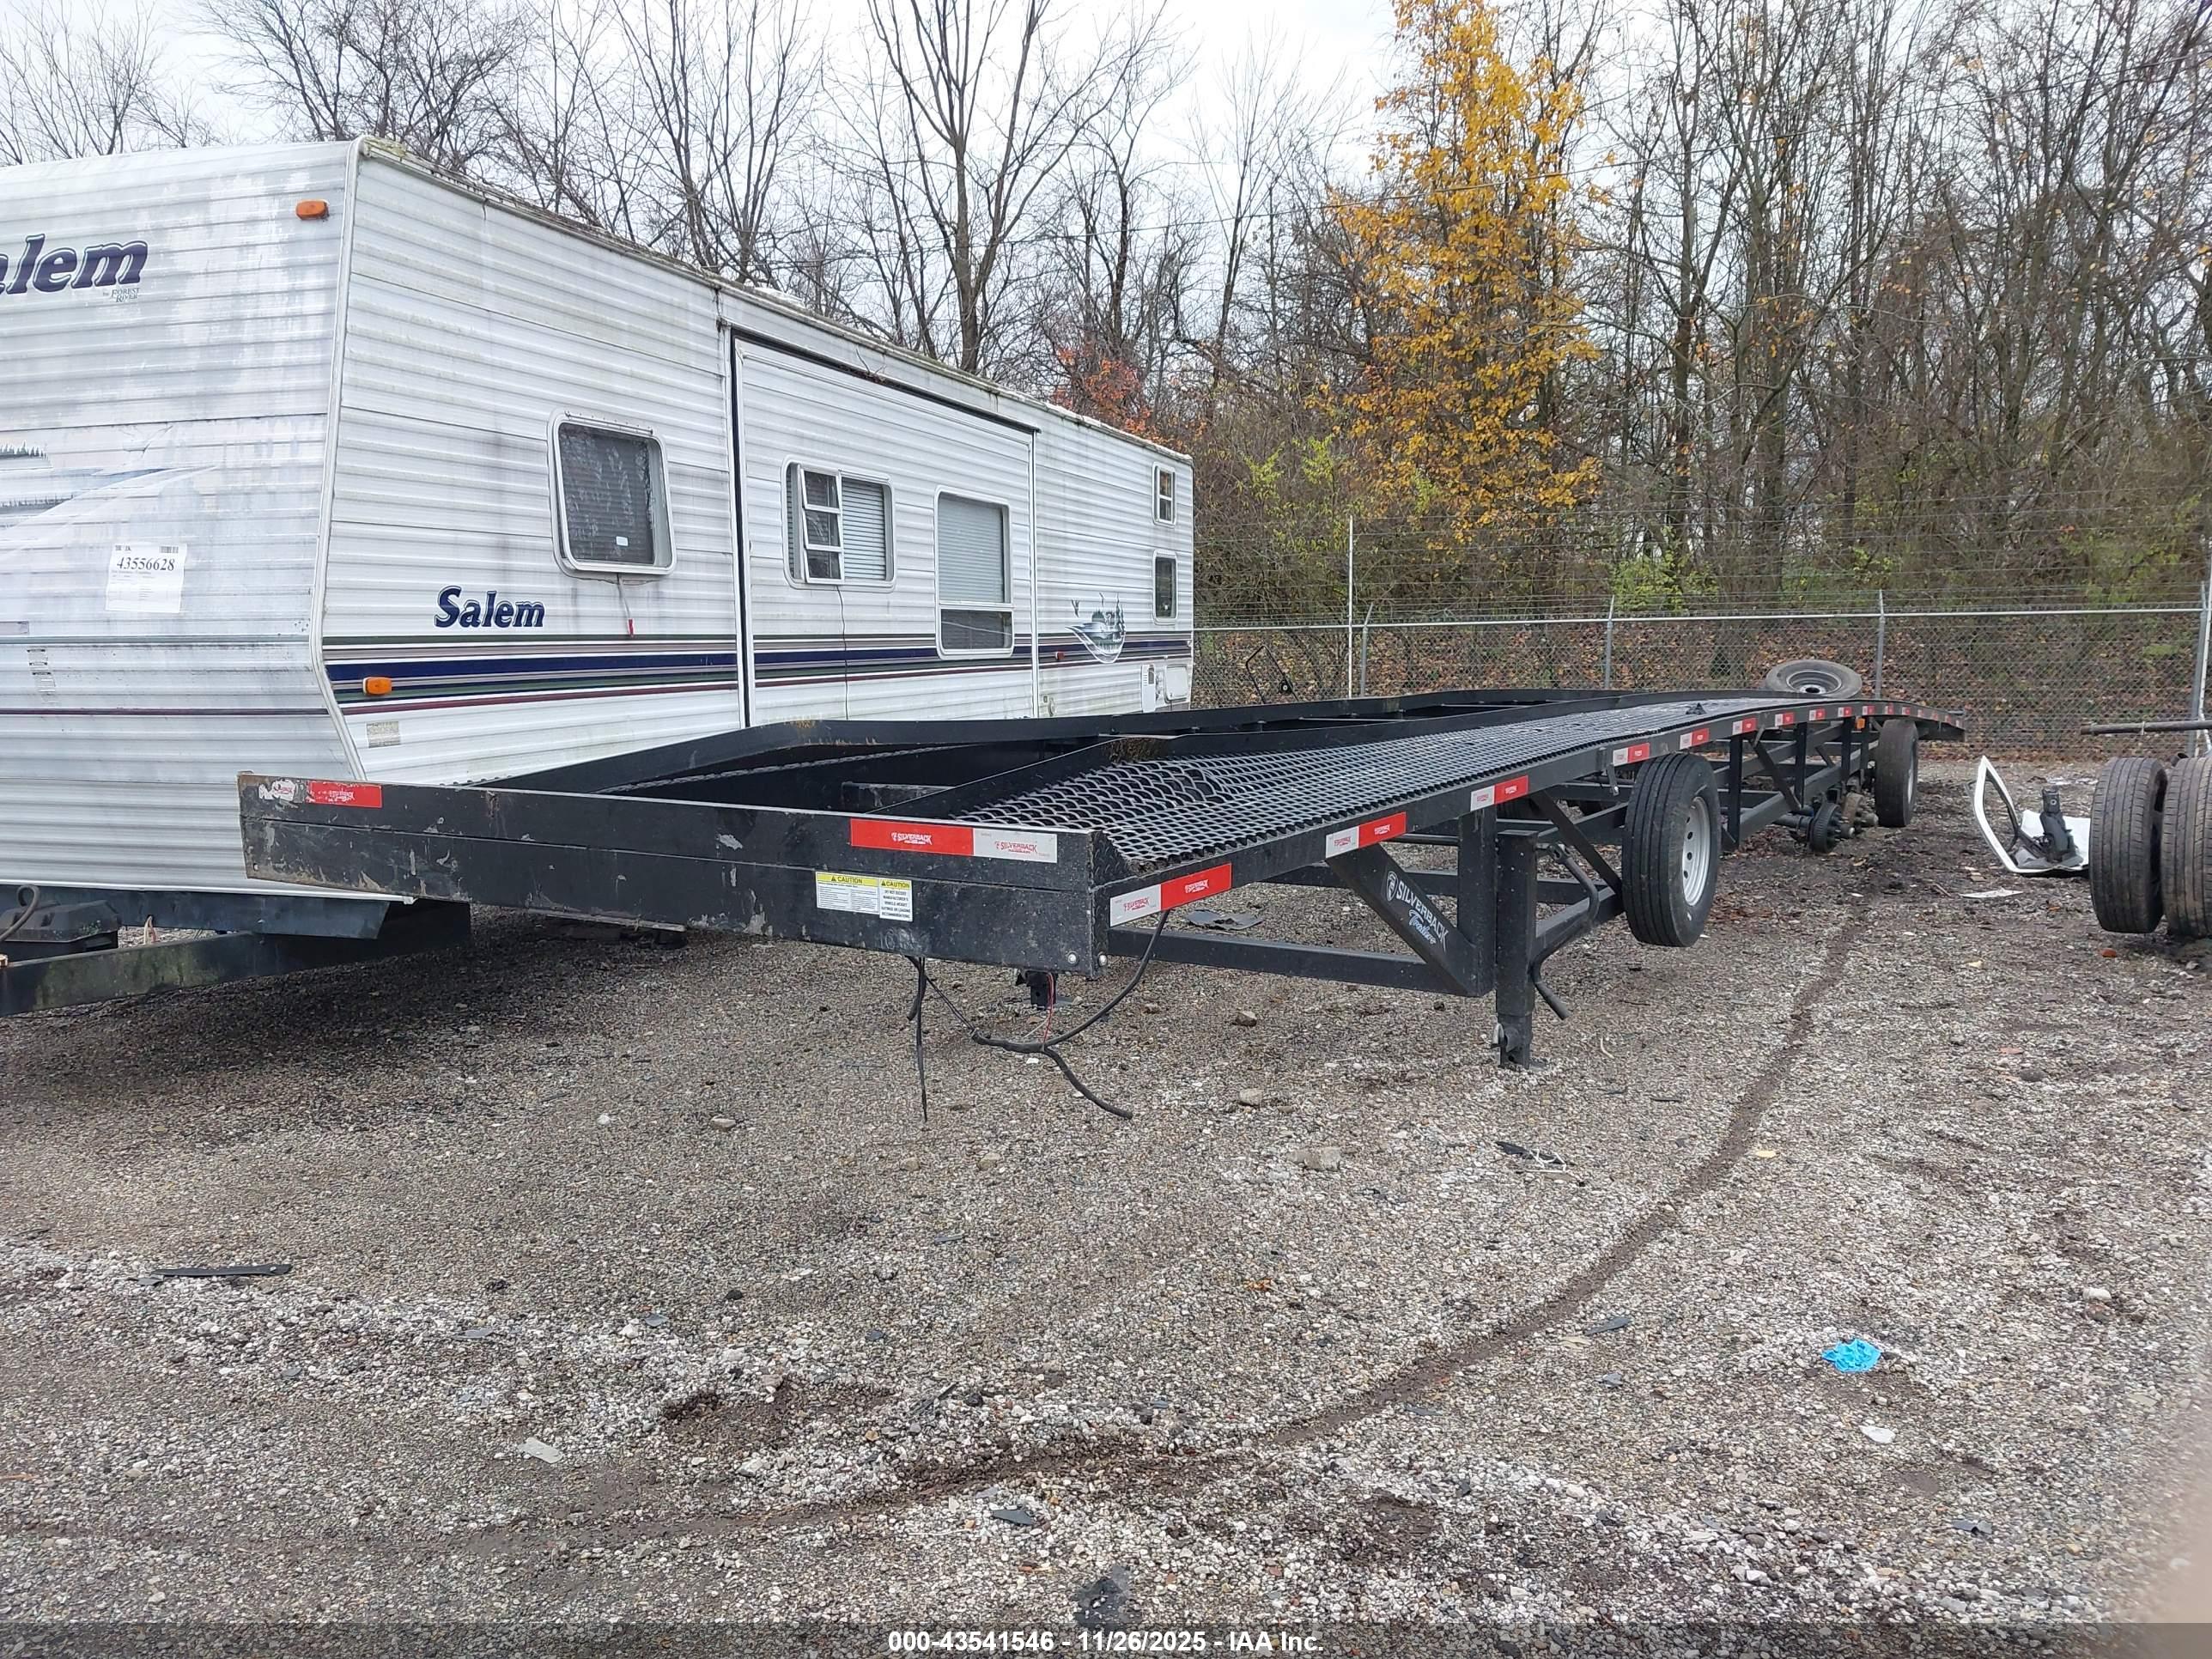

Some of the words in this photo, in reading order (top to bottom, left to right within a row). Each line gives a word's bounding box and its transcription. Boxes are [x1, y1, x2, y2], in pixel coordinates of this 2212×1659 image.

[111, 287, 141, 297] FOREST
[116, 294, 138, 302] RIVER
[117, 556, 175, 571] 43556628
[434, 585, 545, 628] Salem
[897, 831, 933, 845] SILVERBACK
[1000, 841, 1038, 853] SILVERBACK
[1396, 880, 1449, 952] SILVERBACK
